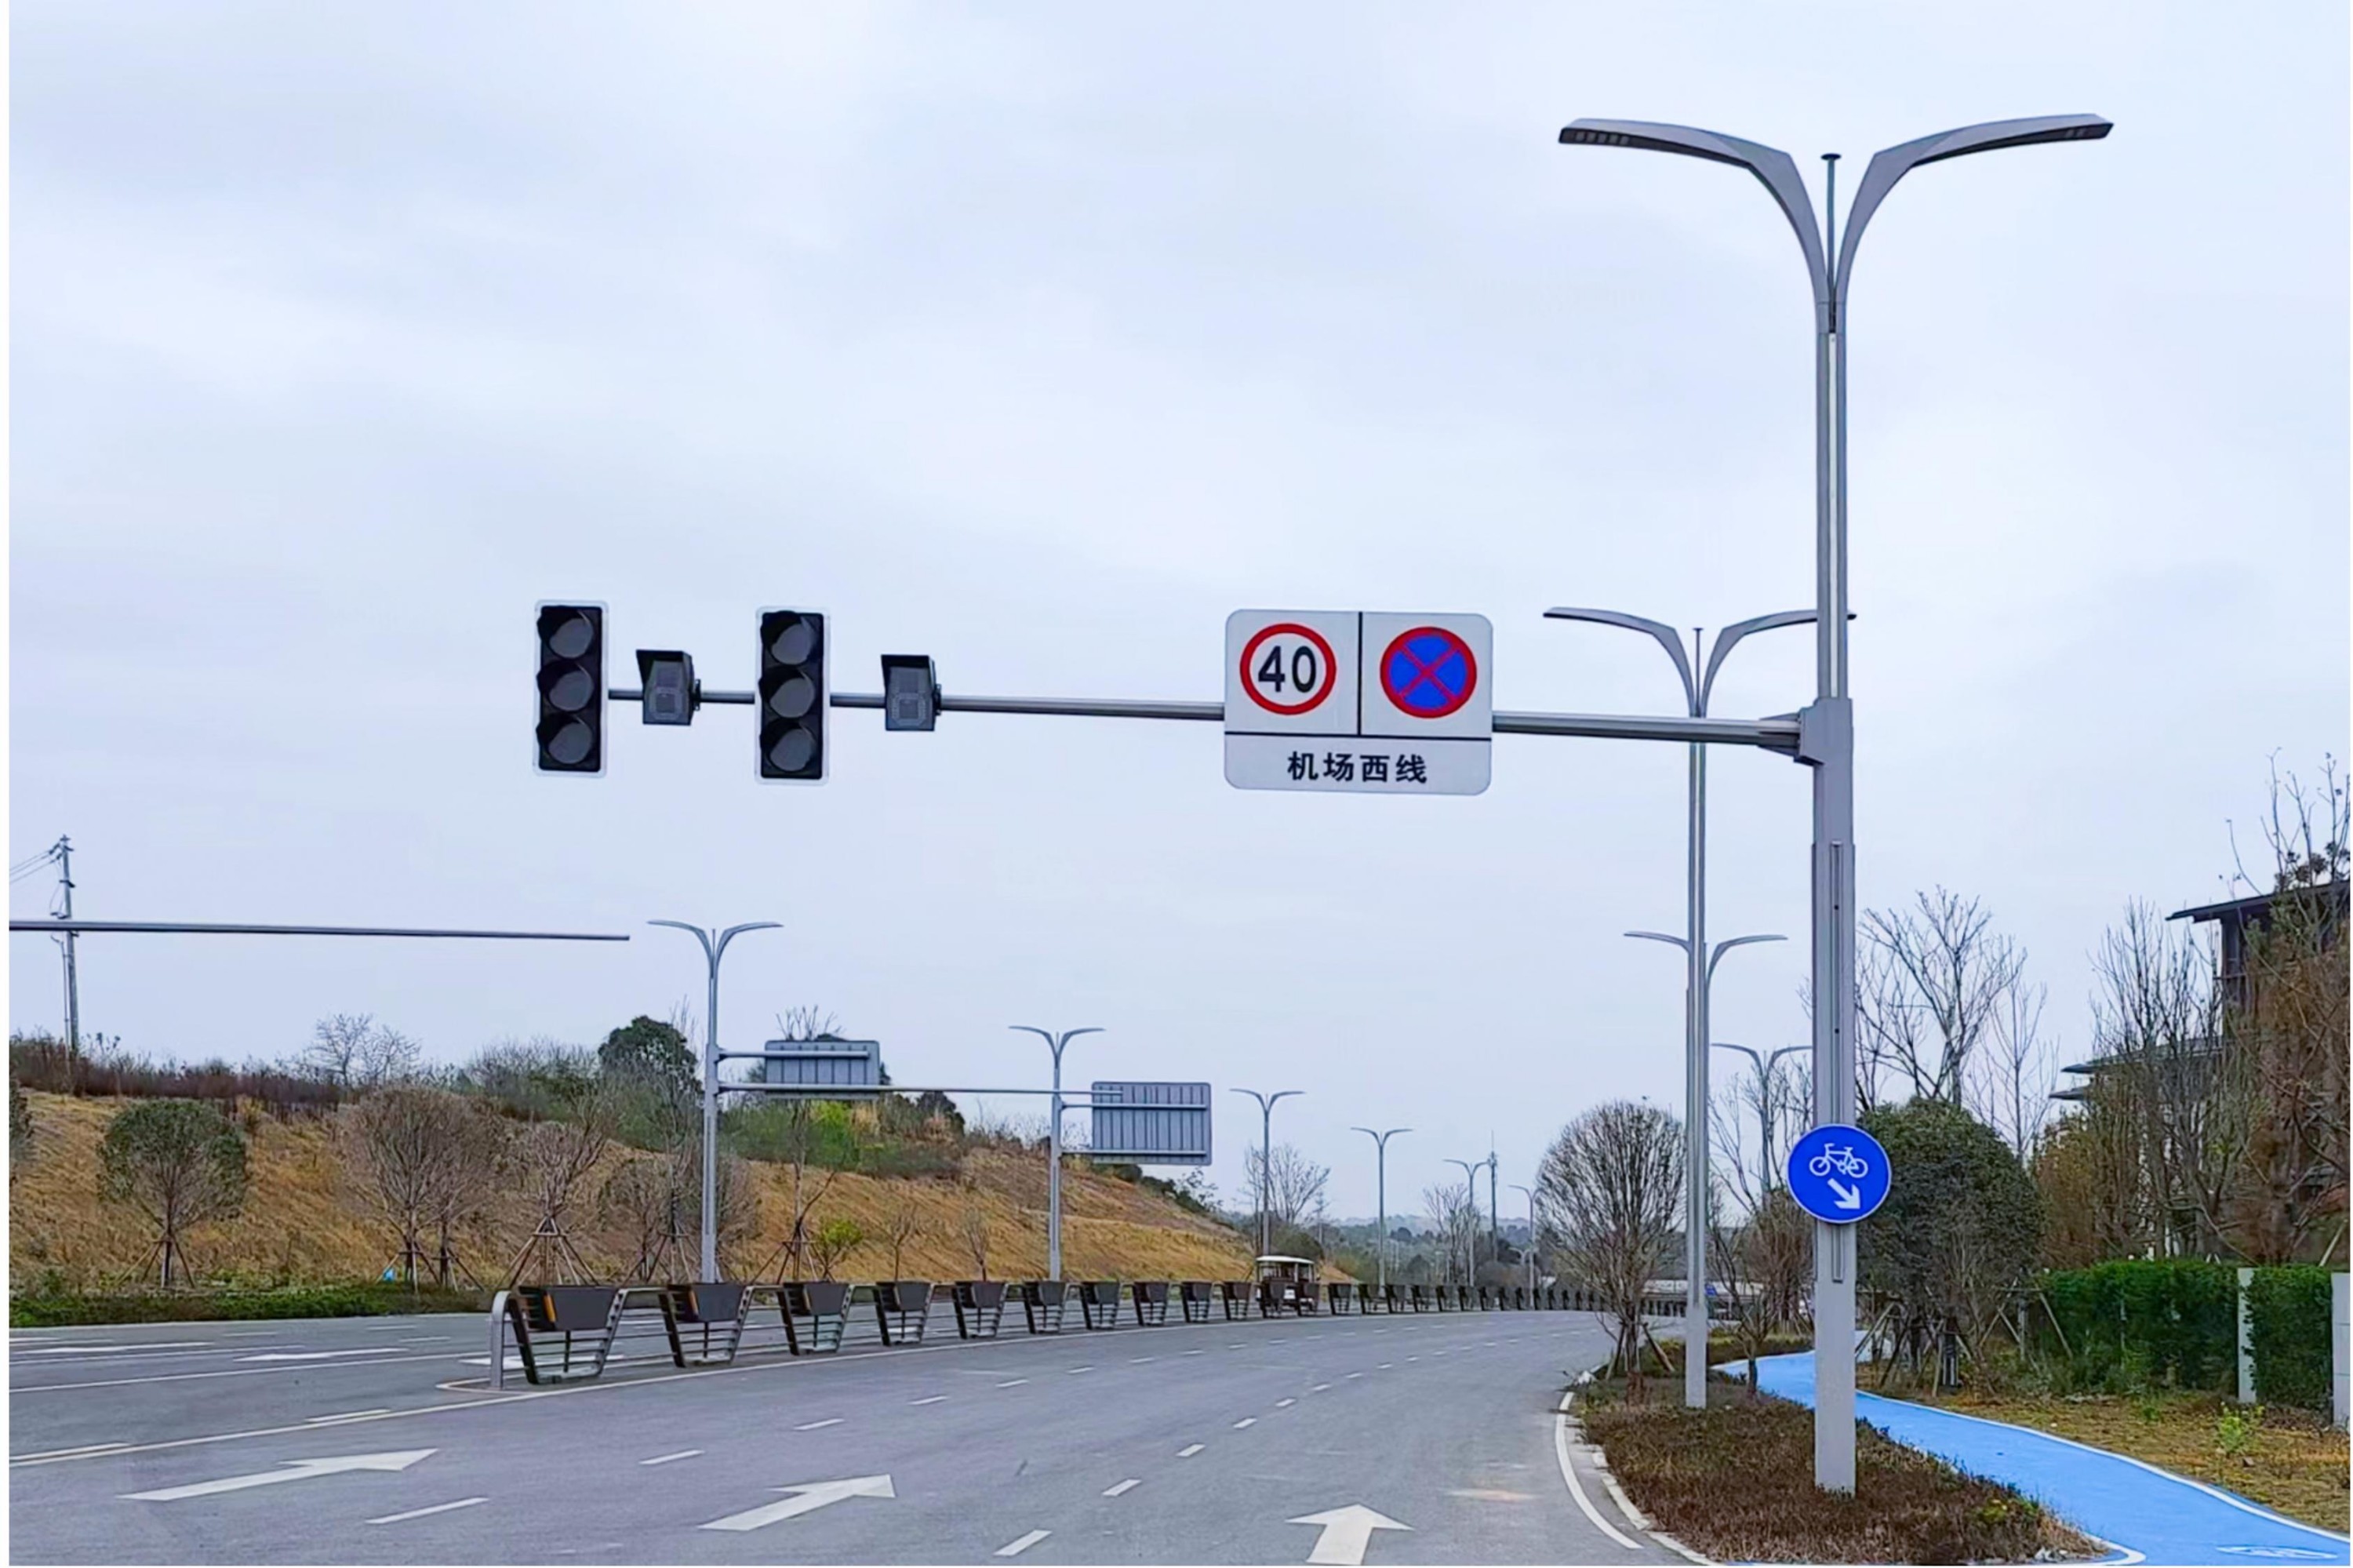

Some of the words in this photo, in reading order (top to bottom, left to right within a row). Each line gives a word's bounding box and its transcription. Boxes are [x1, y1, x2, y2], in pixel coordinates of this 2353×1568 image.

[1257, 646, 1316, 693] 40
[1287, 751, 1427, 784] 机场西线
